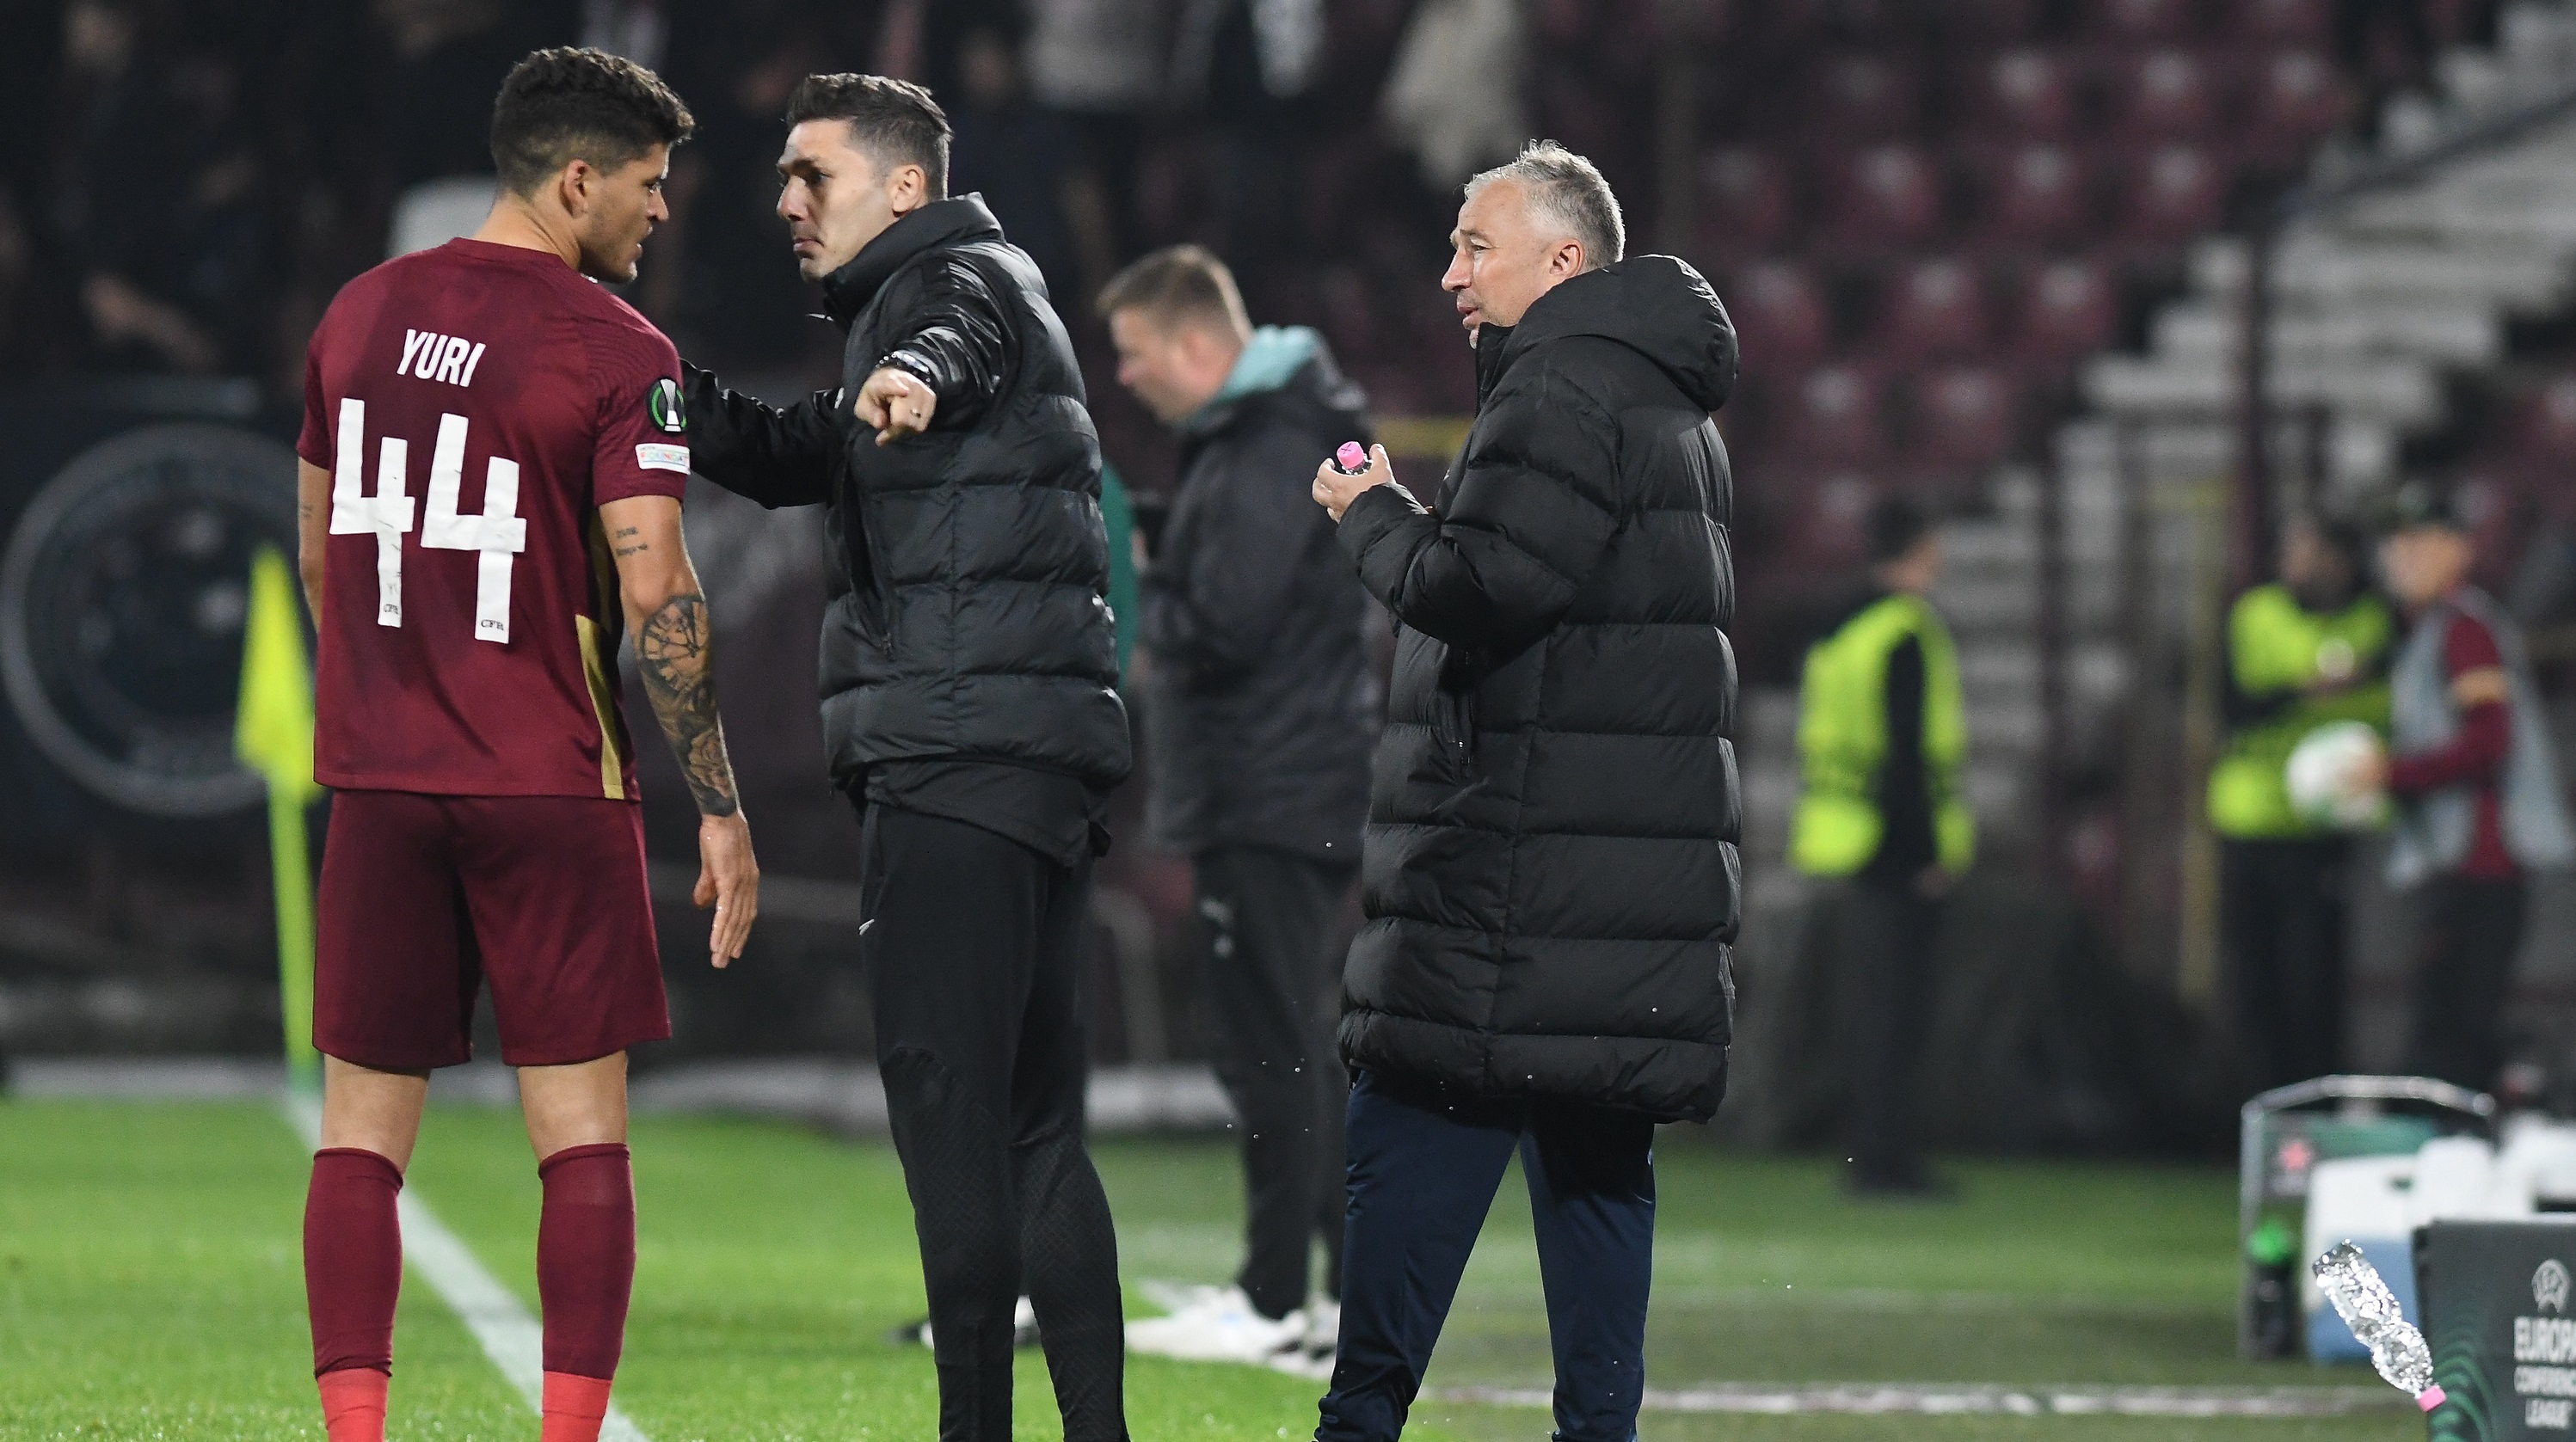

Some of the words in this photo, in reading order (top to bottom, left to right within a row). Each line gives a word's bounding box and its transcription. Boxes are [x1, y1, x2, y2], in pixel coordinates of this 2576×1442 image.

[397, 328, 486, 387] YURI
[329, 397, 526, 644] 44
[481, 619, 504, 630] CFR
